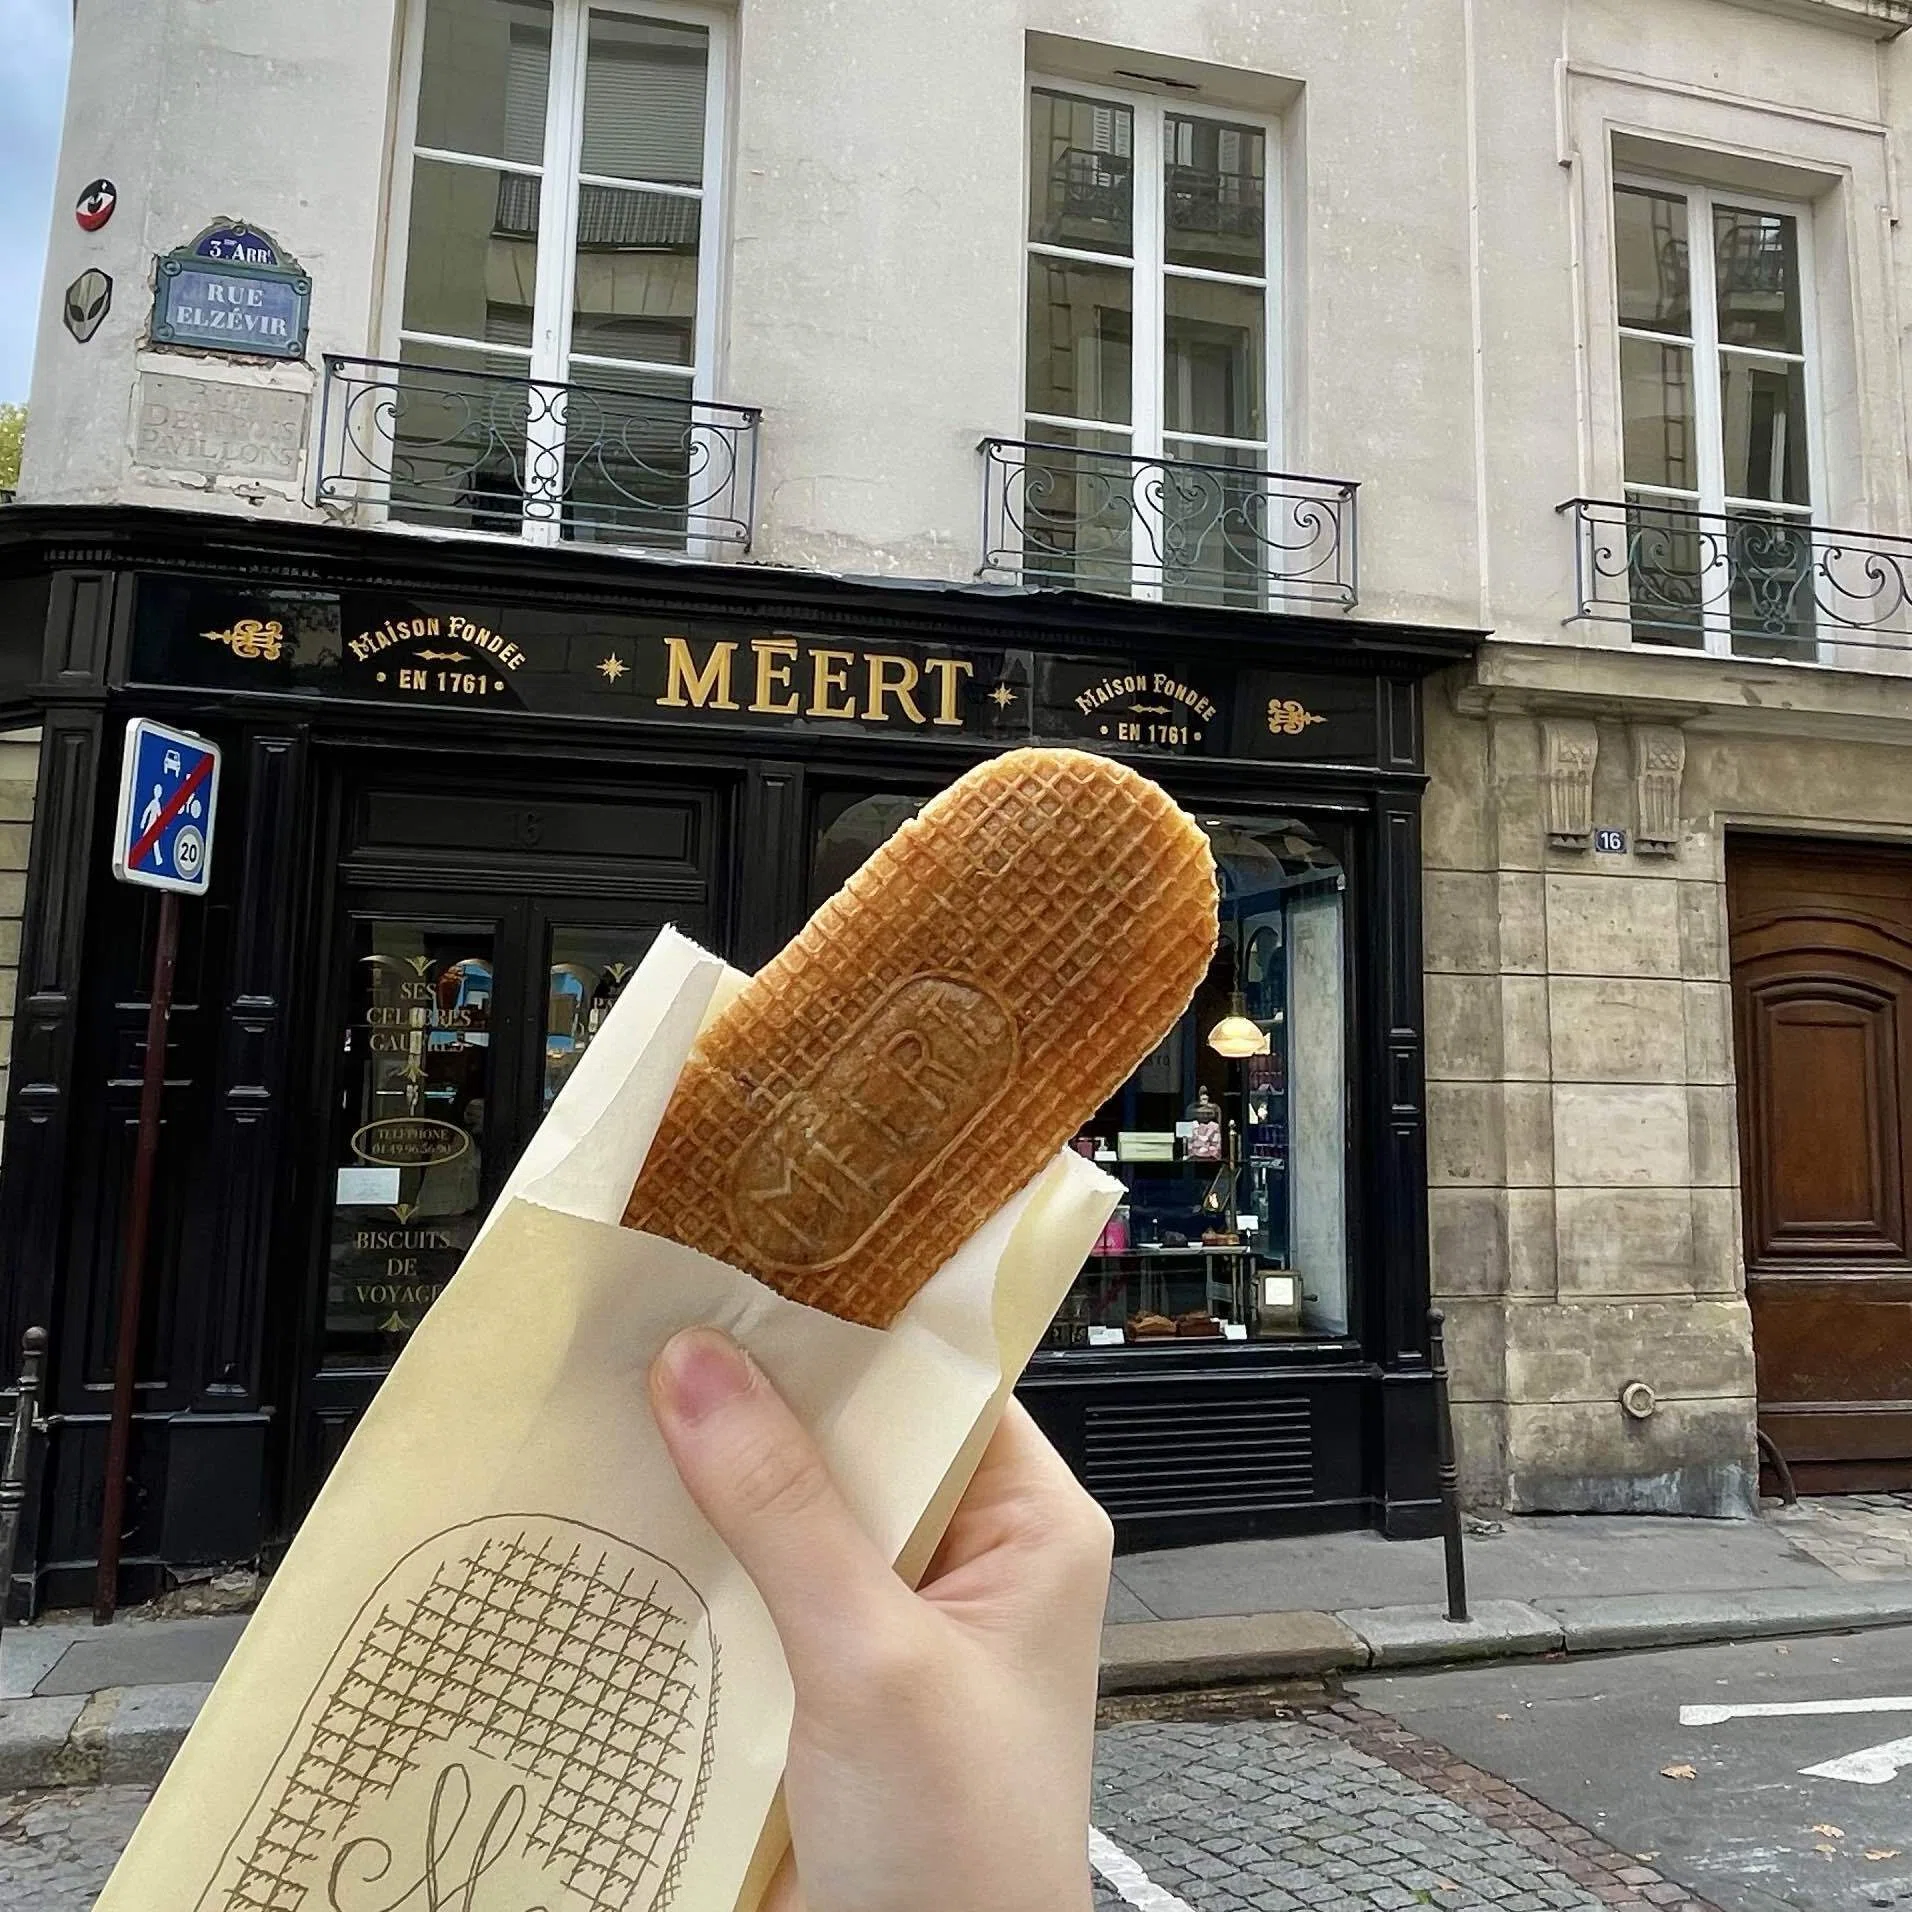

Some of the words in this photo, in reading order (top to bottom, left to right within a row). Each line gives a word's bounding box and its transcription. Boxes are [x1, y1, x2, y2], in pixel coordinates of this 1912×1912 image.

[207, 283, 264, 307] RUE
[176, 305, 288, 336] ELZÉVIR
[399, 669, 428, 690] EN
[437, 672, 487, 695] 1761
[1118, 722, 1141, 741] EN
[1148, 724, 1188, 745] 1761
[1600, 832, 1621, 849] 16
[180, 842, 197, 863] 20
[400, 982, 437, 1000] SES
[366, 1007, 472, 1027] CELBRES
[369, 1033, 464, 1052] GAURES
[356, 1231, 450, 1249] BISCUITS
[387, 1258, 417, 1276] DE
